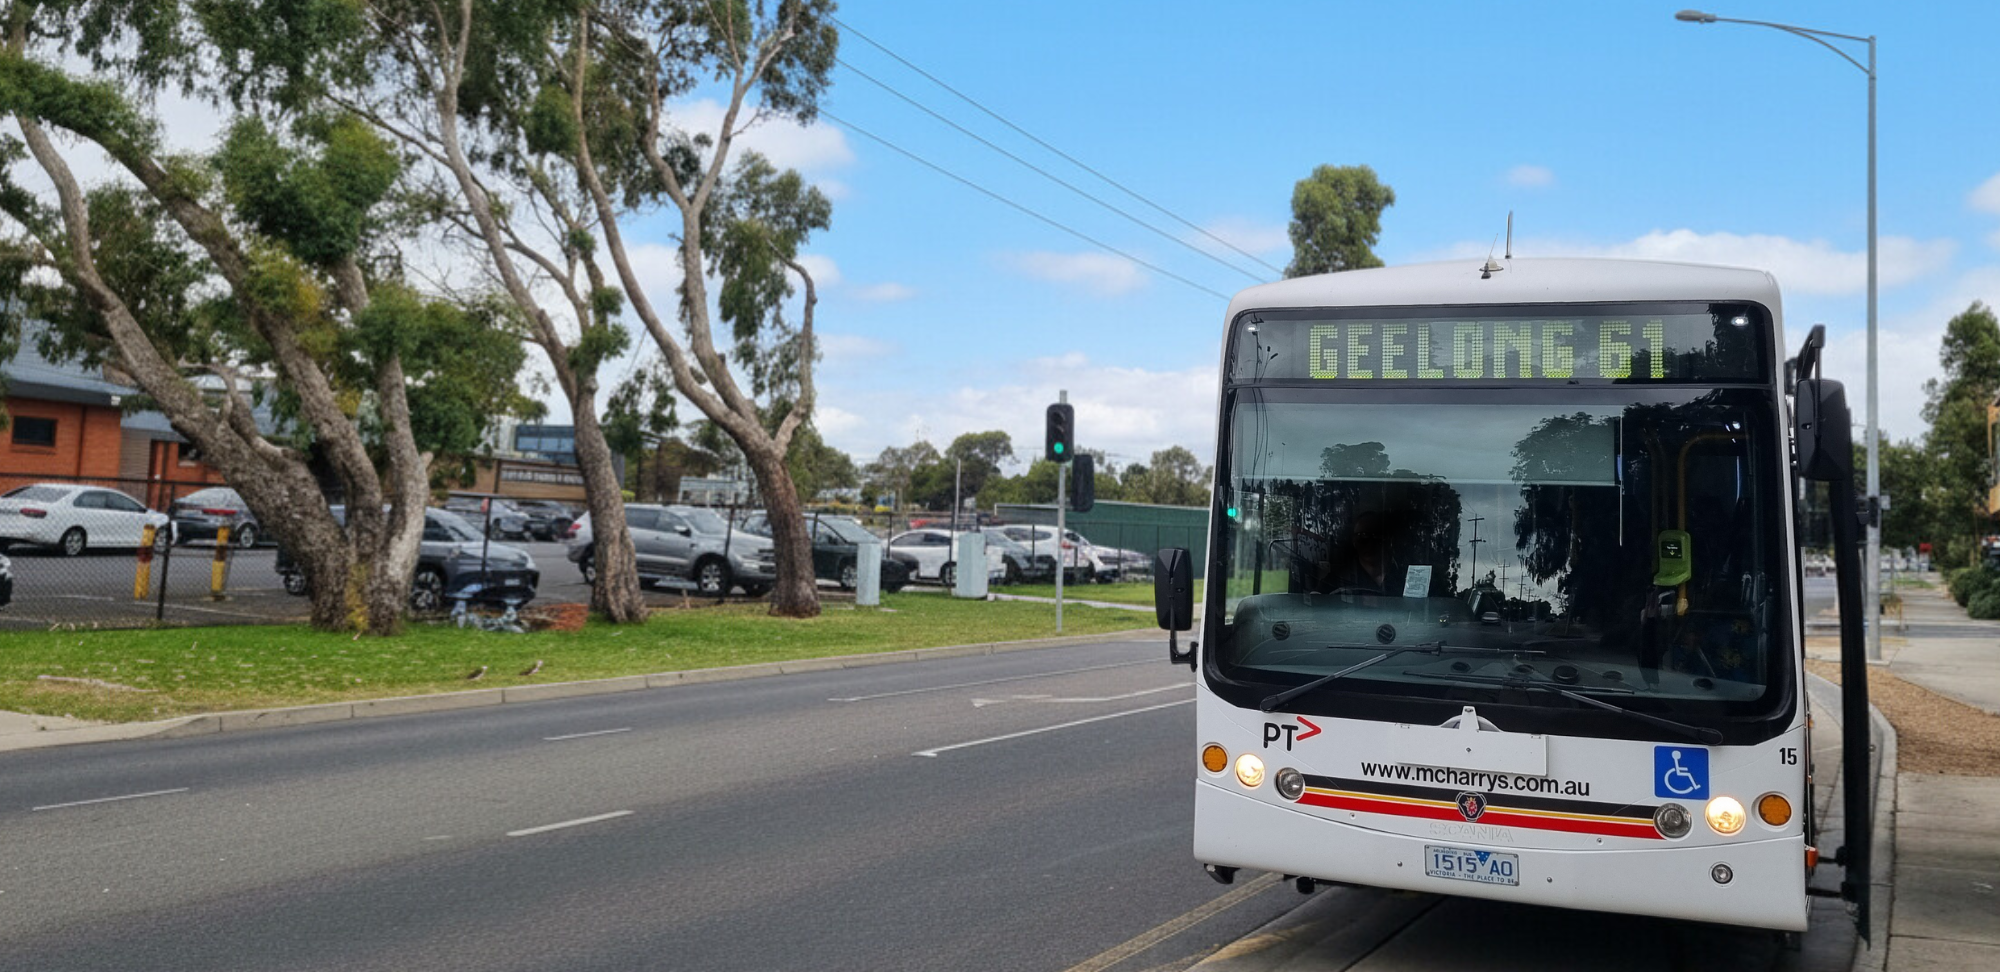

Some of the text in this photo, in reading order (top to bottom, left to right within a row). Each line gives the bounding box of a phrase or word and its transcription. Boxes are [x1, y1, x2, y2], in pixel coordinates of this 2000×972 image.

[1309, 319, 1664, 379] GEELONG 61
[1779, 747, 1798, 765] 15
[1361, 762, 1590, 797] www.mcharrys.com.au
[1429, 821, 1514, 843] SCANIA
[1429, 869, 1456, 877] VICTORIA
[1434, 853, 1477, 874] 1515
